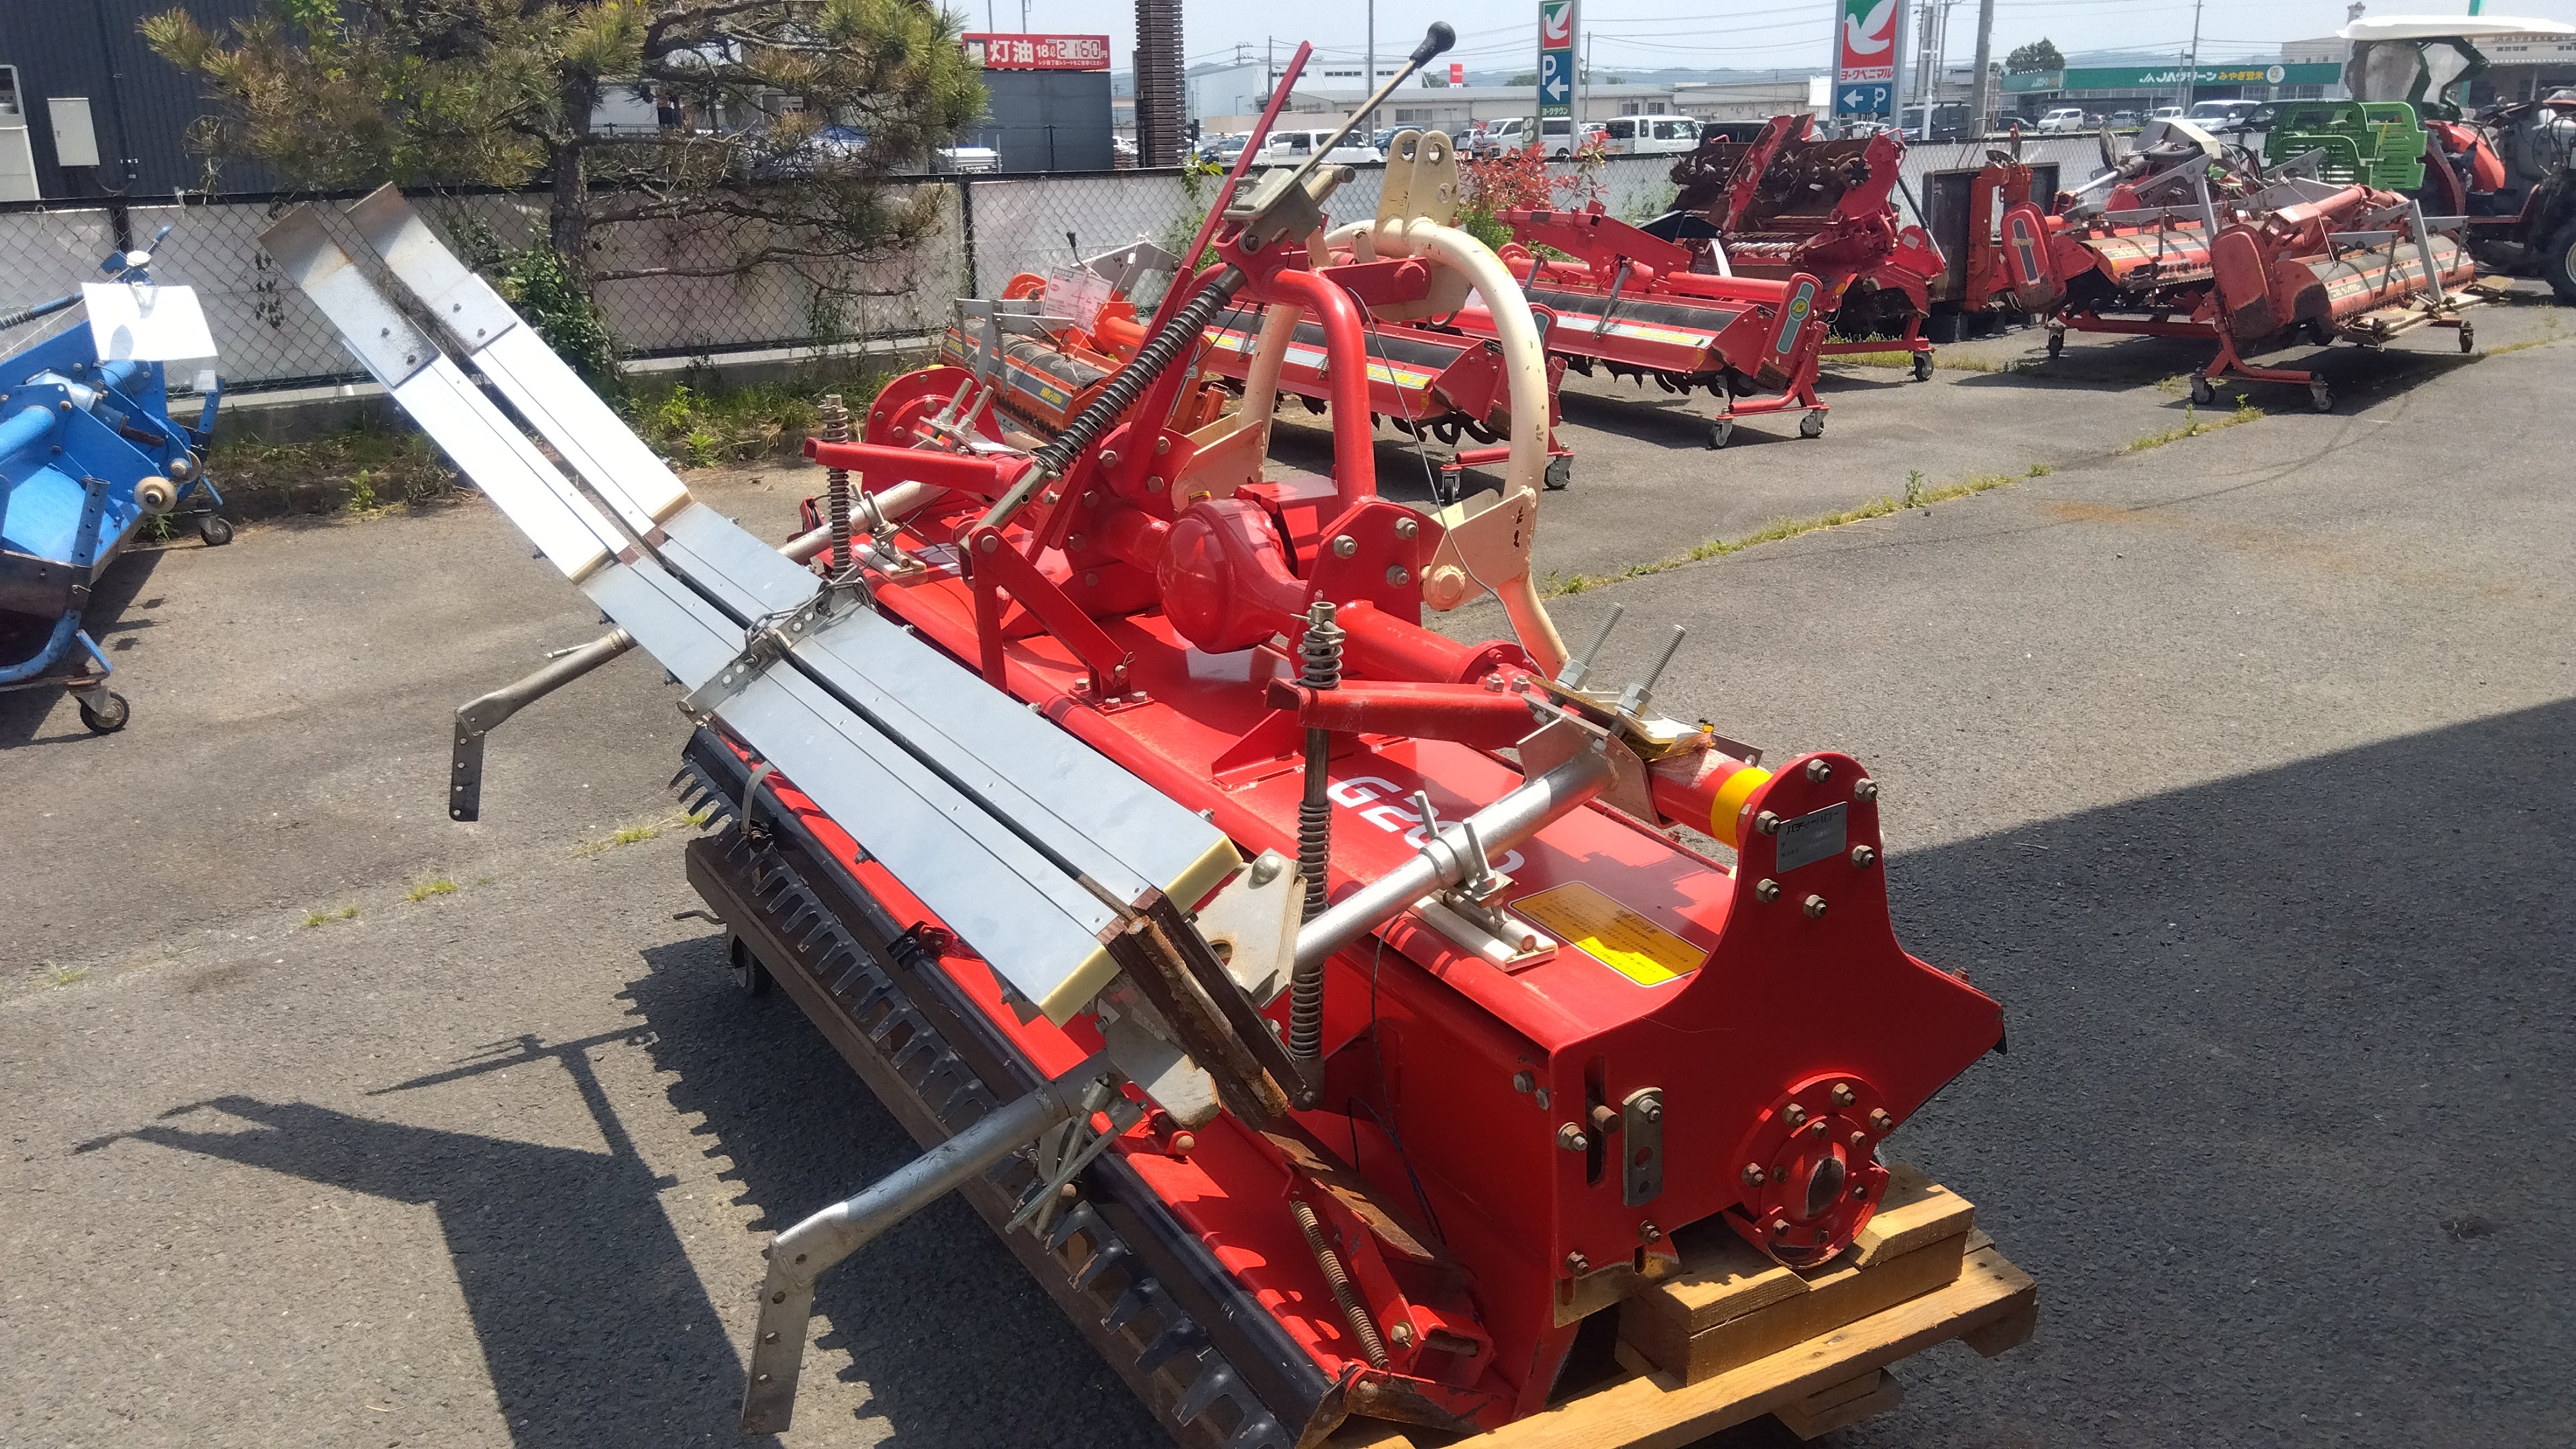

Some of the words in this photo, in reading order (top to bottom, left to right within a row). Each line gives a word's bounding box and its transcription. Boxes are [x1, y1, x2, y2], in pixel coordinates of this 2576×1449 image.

[989, 40, 1034, 63] 灯油
[1542, 54, 1557, 86] P
[1839, 68, 1894, 81] ヨークベニマル
[1873, 87, 1886, 108] P
[1542, 107, 1568, 116] ヨークタウン
